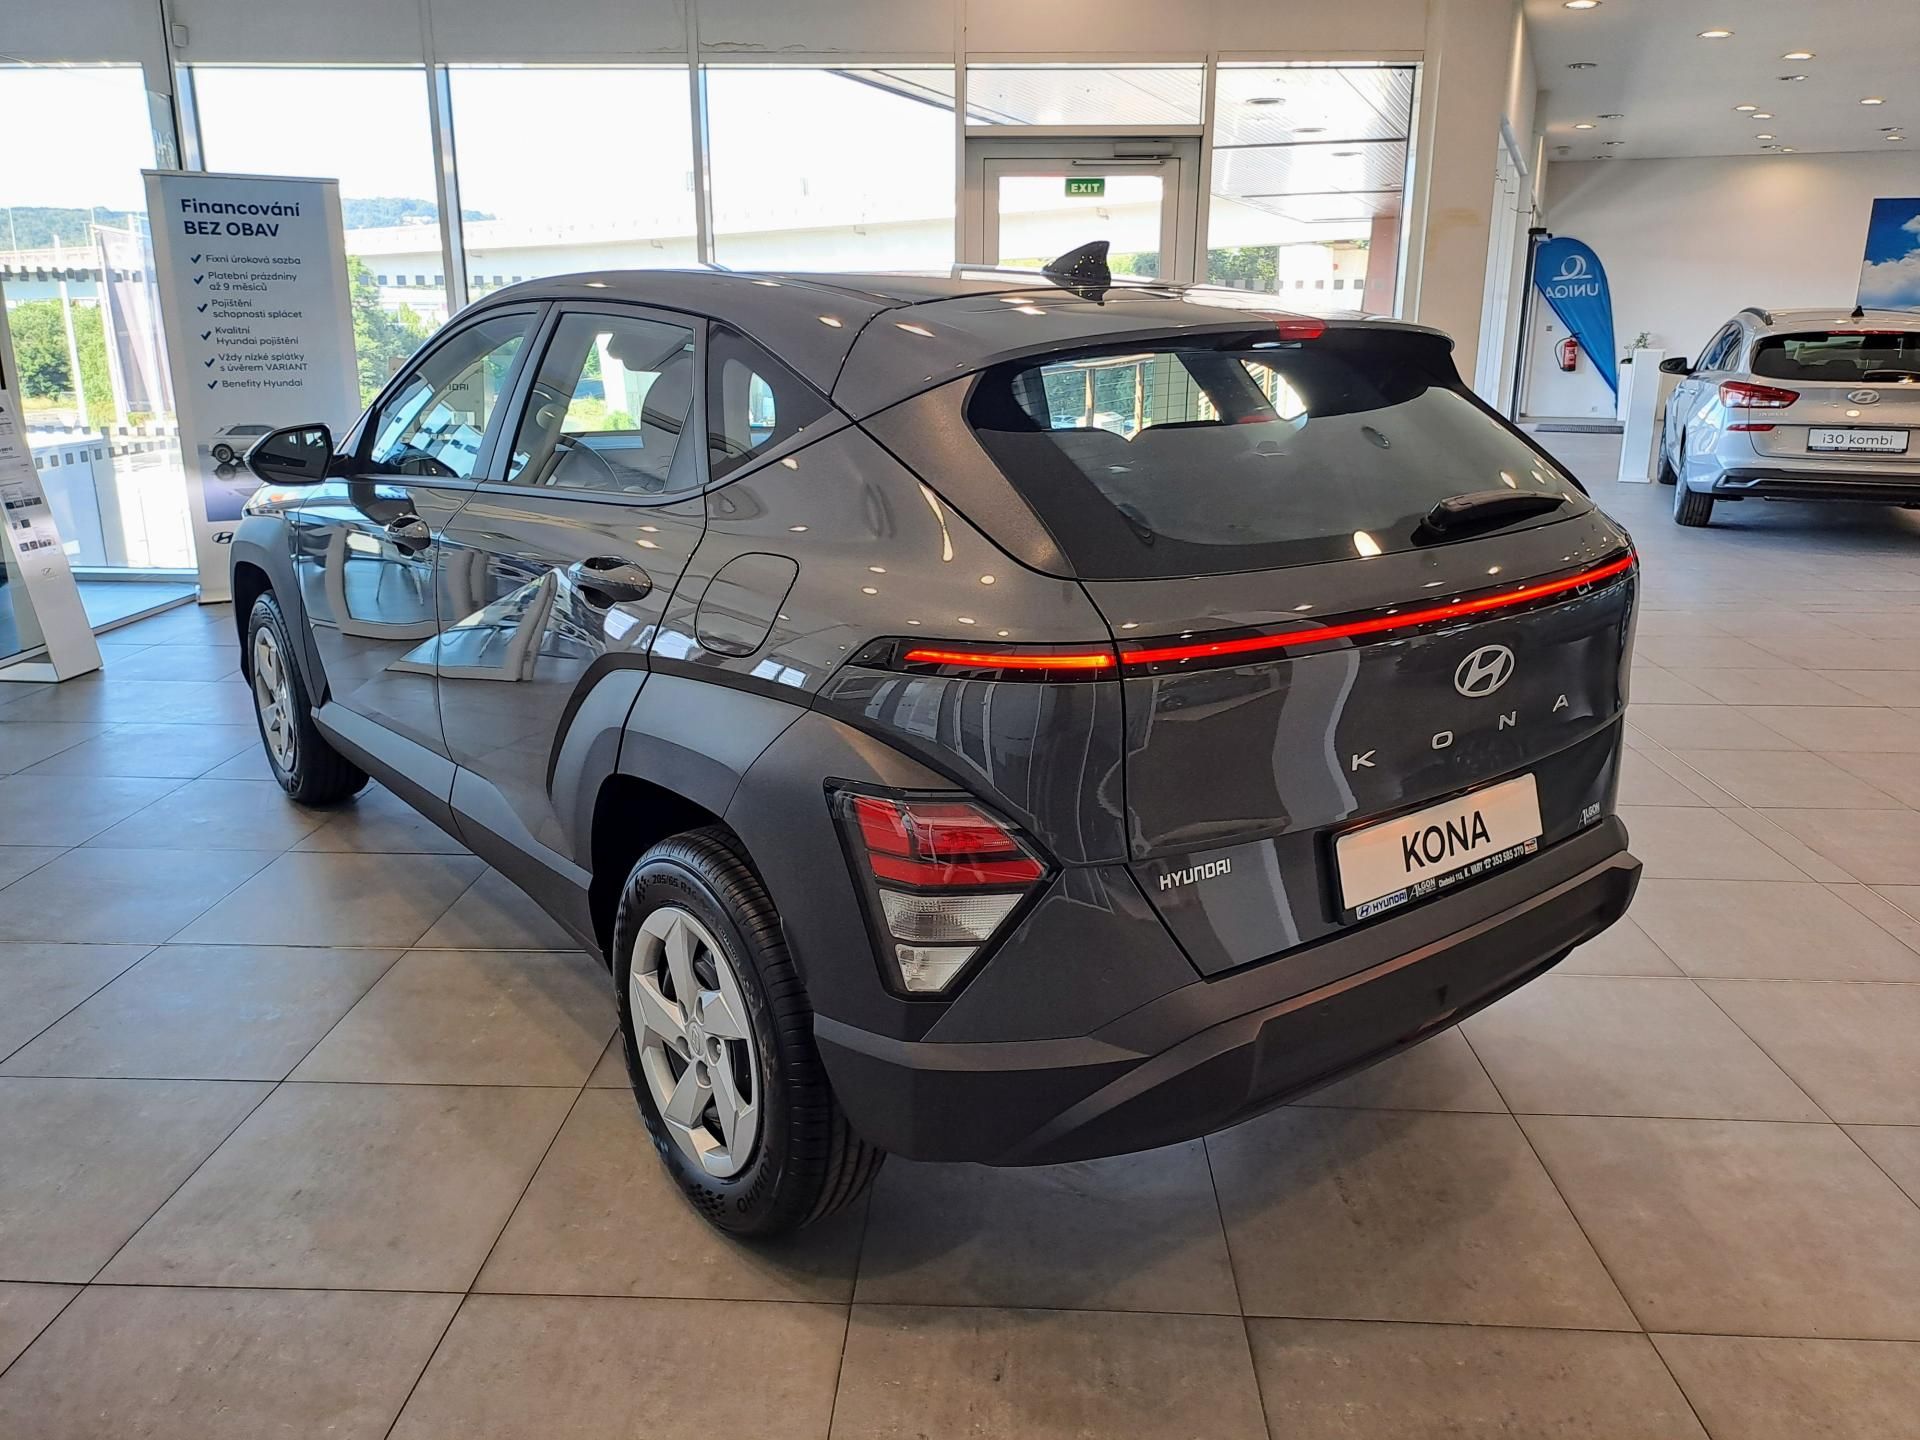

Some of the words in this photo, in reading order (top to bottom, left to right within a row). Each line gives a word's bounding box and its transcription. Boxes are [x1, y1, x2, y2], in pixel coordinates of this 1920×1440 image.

[1071, 183, 1100, 193] EXIT
[181, 198, 300, 216] Financování
[184, 221, 222, 235] BEZ
[226, 222, 279, 237] OBAV
[206, 254, 229, 263] Fixní
[231, 255, 270, 264] úroková
[272, 256, 301, 265] sazba
[208, 271, 248, 280] Platební
[251, 272, 297, 282] prázdniny
[209, 282, 221, 291] až
[223, 282, 230, 291] 9
[232, 282, 267, 291] měsíců
[211, 298, 252, 308] Pojištění
[213, 310, 266, 319] schopnosti
[268, 310, 302, 319] splácet
[215, 326, 250, 335] Kvalitní
[216, 337, 257, 346] Hyundai
[260, 336, 299, 346] pojištění
[218, 353, 242, 362] Vždy
[245, 353, 269, 361] nízké
[271, 352, 304, 361] splátky
[227, 364, 263, 372] úvěrem
[265, 363, 308, 371] VARIANT
[222, 379, 261, 388] Benefity
[263, 379, 303, 388] Hyundai
[1823, 433, 1845, 445] i30
[1849, 434, 1893, 446] kombi
[1351, 694, 1569, 772] KONA
[1402, 810, 1491, 873] KONA
[1160, 858, 1231, 891] HYUNDAI
[1372, 891, 1408, 912] HYUNDAI
[1409, 878, 1436, 900] ALGON
